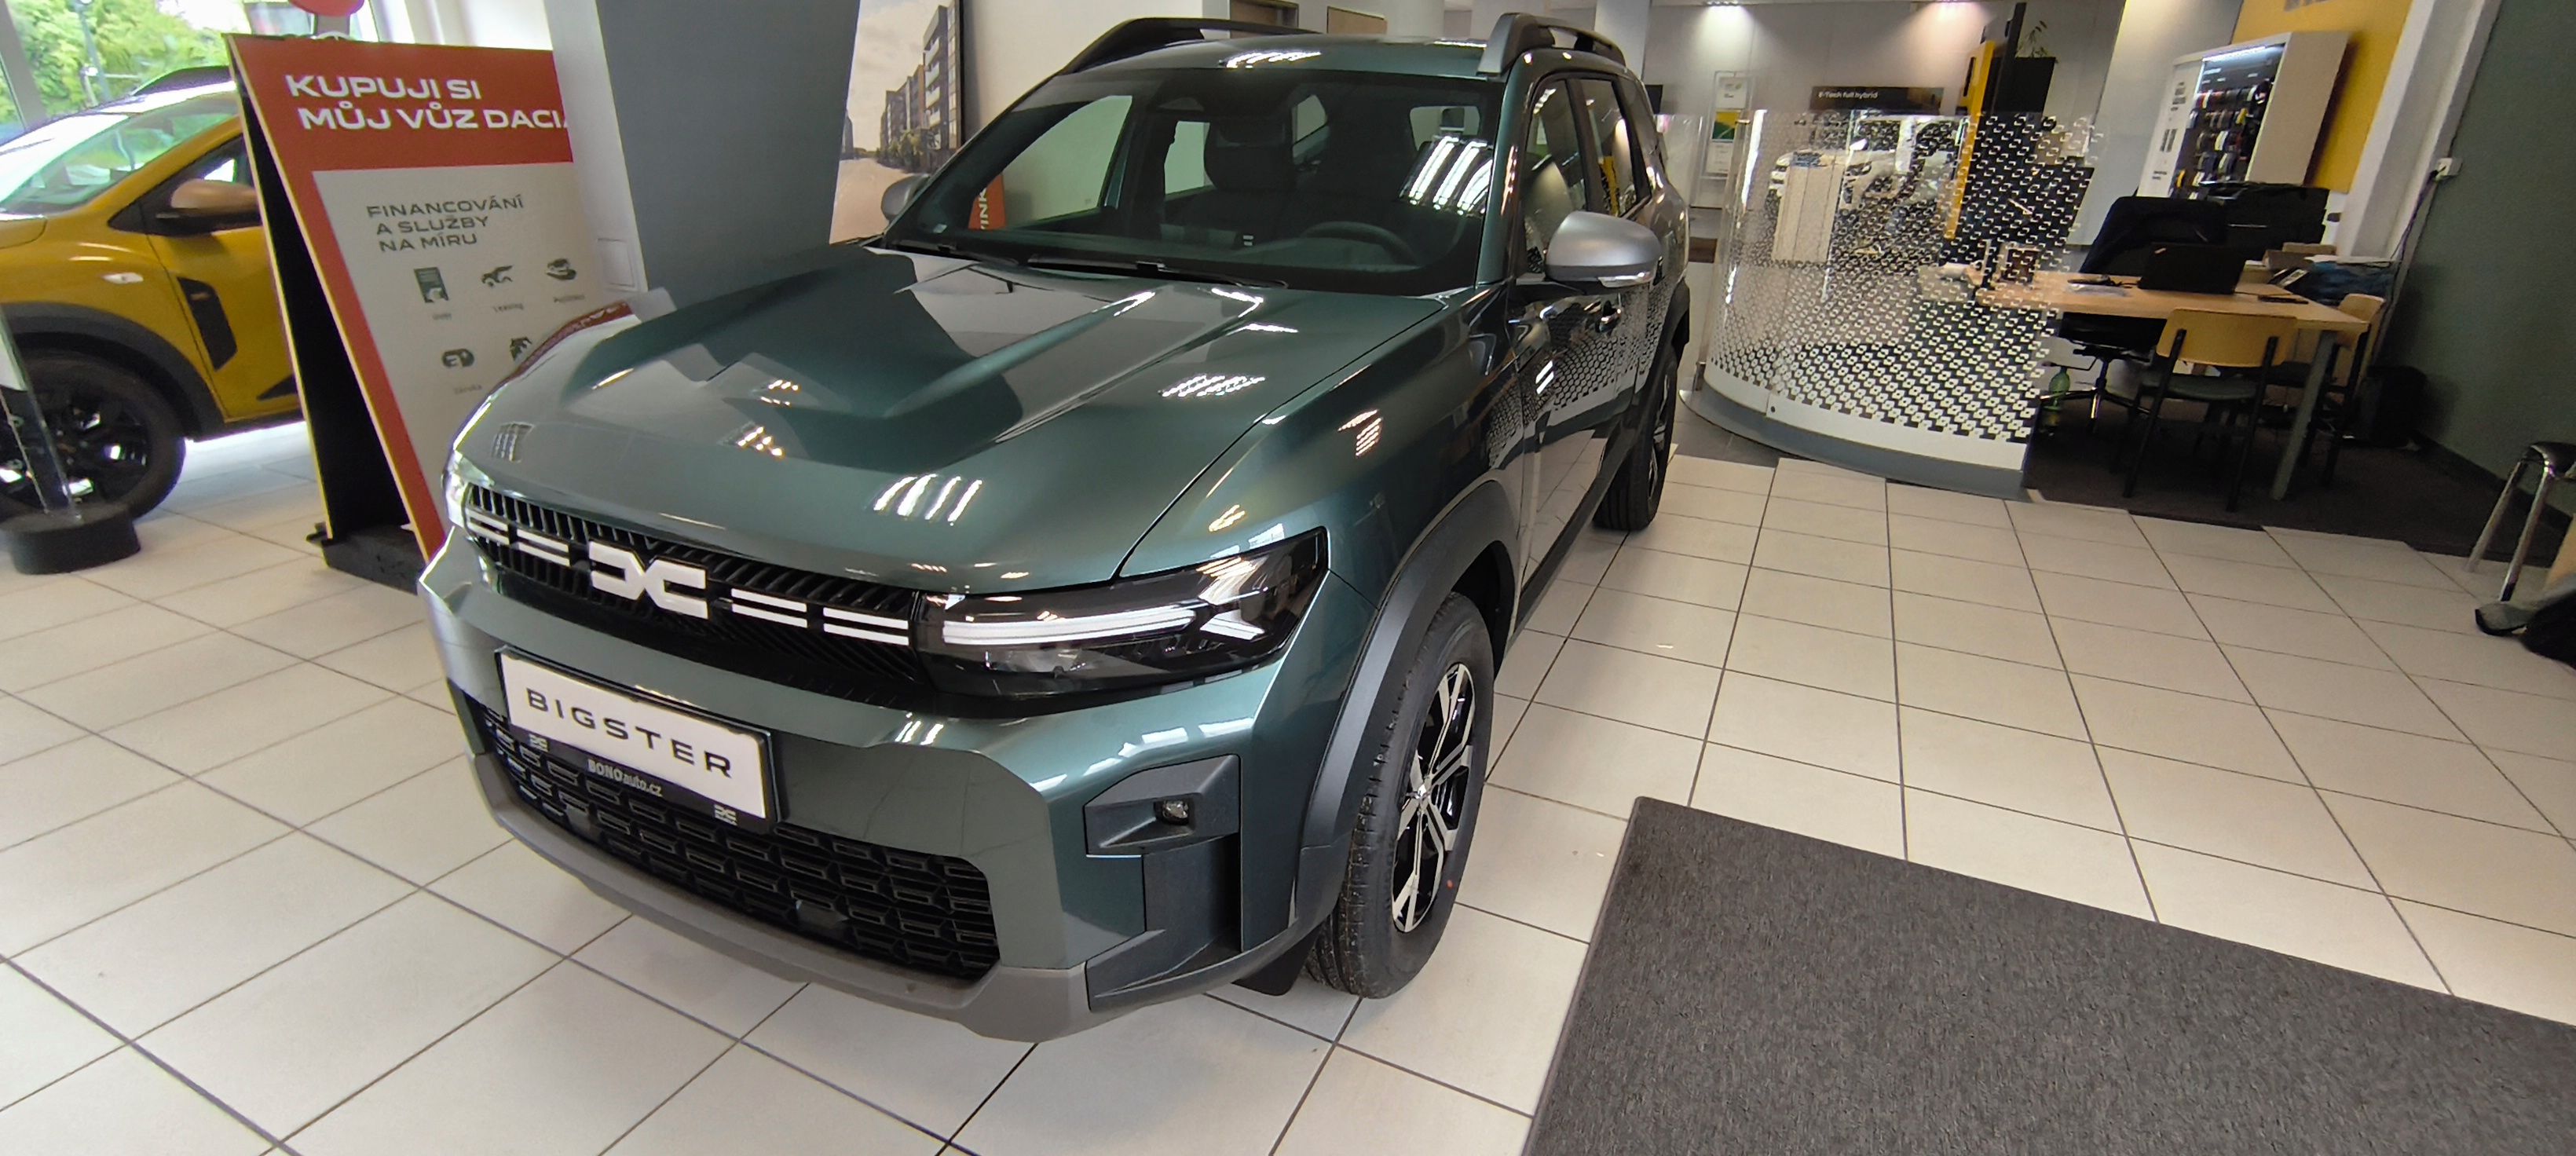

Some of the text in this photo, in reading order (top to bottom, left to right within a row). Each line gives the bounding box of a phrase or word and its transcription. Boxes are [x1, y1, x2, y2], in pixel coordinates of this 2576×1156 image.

[285, 75, 482, 100] KUPUJI SI
[297, 100, 568, 130] MŮJ VŮZ DACI
[366, 194, 525, 218] FINANCOVÁNÍ
[376, 214, 488, 236] A SLUŽBY
[379, 232, 478, 253] NA MÍRU
[525, 687, 733, 779] BIGSTER
